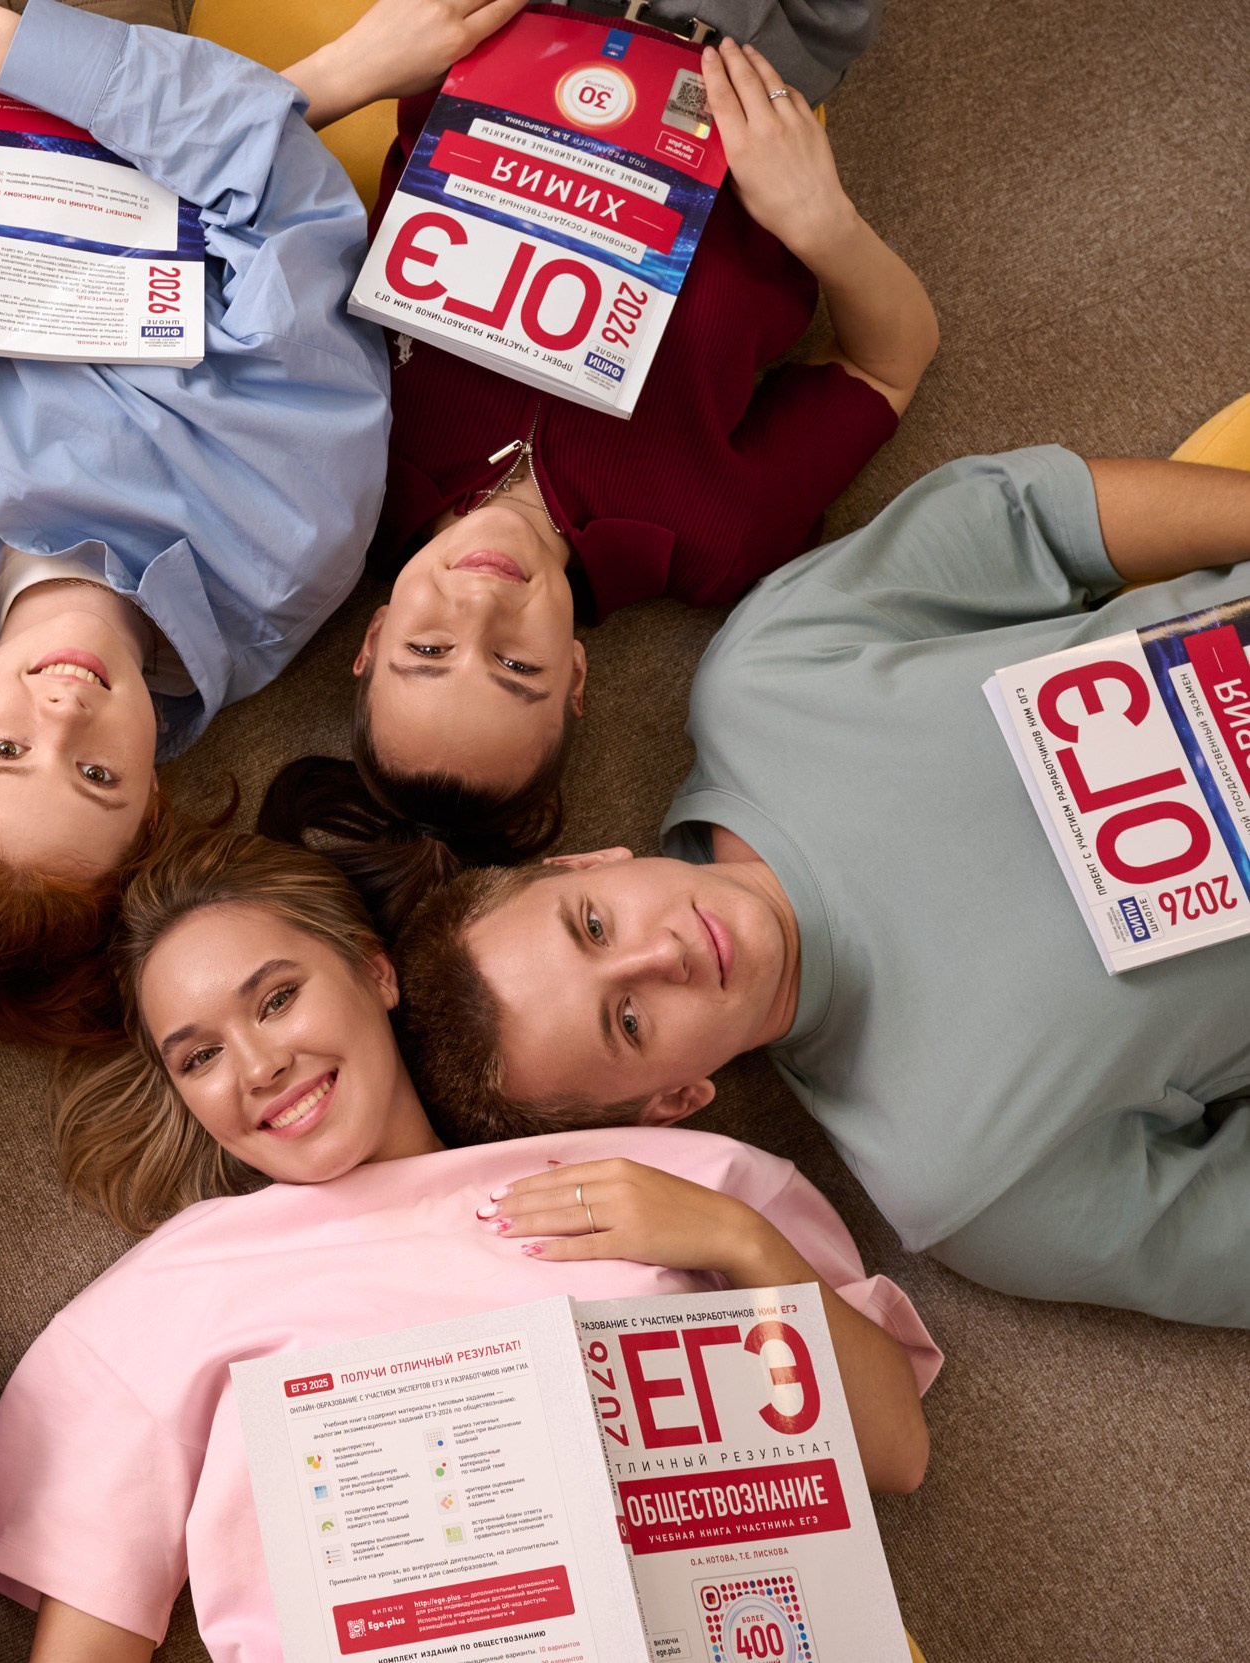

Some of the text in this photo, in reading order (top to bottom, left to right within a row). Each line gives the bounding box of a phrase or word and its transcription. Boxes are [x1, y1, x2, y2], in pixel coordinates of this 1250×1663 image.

[576, 85, 612, 110] 30
[480, 126, 657, 193] ТИПОВЫЕ ЭКЗАМЕНАЦИОННЫЕ ВАРИАНТЫ
[503, 115, 646, 168] ПОД РЕДАКЦИЕЙ ДОБРОТИНА
[3, 190, 54, 201] АНГЛИЙСКОМУ
[69, 200, 102, 212] ИЗДАНИЙ
[491, 156, 626, 222] ХИМИЯ
[105, 208, 141, 220] КОМПЛЕКТ
[453, 182, 637, 254] ОСНОВНОЙ ГОСУДАРСТВЕННЫЙ ЭКЗАМЕН
[147, 262, 181, 317] 2026
[385, 211, 603, 351] ОГЭ
[144, 327, 180, 335] ФИПИ
[373, 290, 573, 372] ПРОЕКТ С УЧАСТИЕМ РАЗРАБОТЧИКОВ КИМ ОГЭ
[600, 281, 648, 348] 2026
[588, 354, 621, 378] ФИПИ
[594, 345, 624, 364] ШКОЛЕ
[1178, 672, 1247, 812] ГОСУДАРСТВЕННЫЙ ЭКЗАМЕН
[1015, 686, 1107, 895] ПРОЕКТ С УЧАСТИЕМ РАЗРАБОТЧИКОВ КИМ ОГЭ
[1037, 660, 1211, 884] ОГЭ
[1122, 899, 1148, 939] ФИПИ
[1138, 897, 1161, 932] ШКОЛЕ
[1155, 874, 1239, 926] 2026
[630, 1318, 637, 1327] С
[639, 1314, 683, 1326] УЧАСТИЕМ
[686, 1307, 754, 1322] РАЗРАБОТЧИКОВ
[757, 1305, 777, 1317] КИМ
[780, 1304, 797, 1314] ЕГЭ
[340, 1339, 521, 1383] ПОЛУЧИ ОТЛИЧНЫЙ РЕЗУЛЬТАТ!
[289, 1362, 528, 1414] ОНЛАЙН-ОБРАЗОВАНИЕ УЧАСТИЕМ ЭКСПЕРТОВ ЕГЭ РАЗРАБОТЧИКОВ КИМ ГИА
[290, 1377, 329, 1392] ЕГЭ 2025
[618, 1321, 822, 1451] ЕГЭ
[313, 1396, 516, 1440] аналогам экзаменационных заданий ЕГЭ-2026 обществознанию:
[323, 1391, 495, 1429] Учебная книга содержит материалы типовым заданиям
[721, 1441, 832, 1463] РЕЗУЛЬТАТ
[625, 1474, 828, 1528] ОБЩЕСТВОЗНАНИЕ
[648, 1515, 818, 1544] УЧЕБНАЯ КНИГА УЧАСТНИКА ЕГЭ
[329, 1539, 559, 1586] Применяйте уроках, внеурочной деятельности, дополнительных
[705, 1552, 737, 1565] КОТОВА,
[752, 1546, 788, 1559] ЛИСКОВА
[367, 1614, 405, 1631] Ege.plus
[741, 1614, 764, 1624] БОЛЕЕ
[377, 1653, 417, 1663] КОМПЛЕКТ
[420, 1644, 457, 1658] ИЗДАНИЙ
[472, 1629, 546, 1649] ОБЩЕСТВОЗНАНИЮ
[656, 1647, 681, 1658] ege.plus
[732, 1621, 785, 1661] 400
